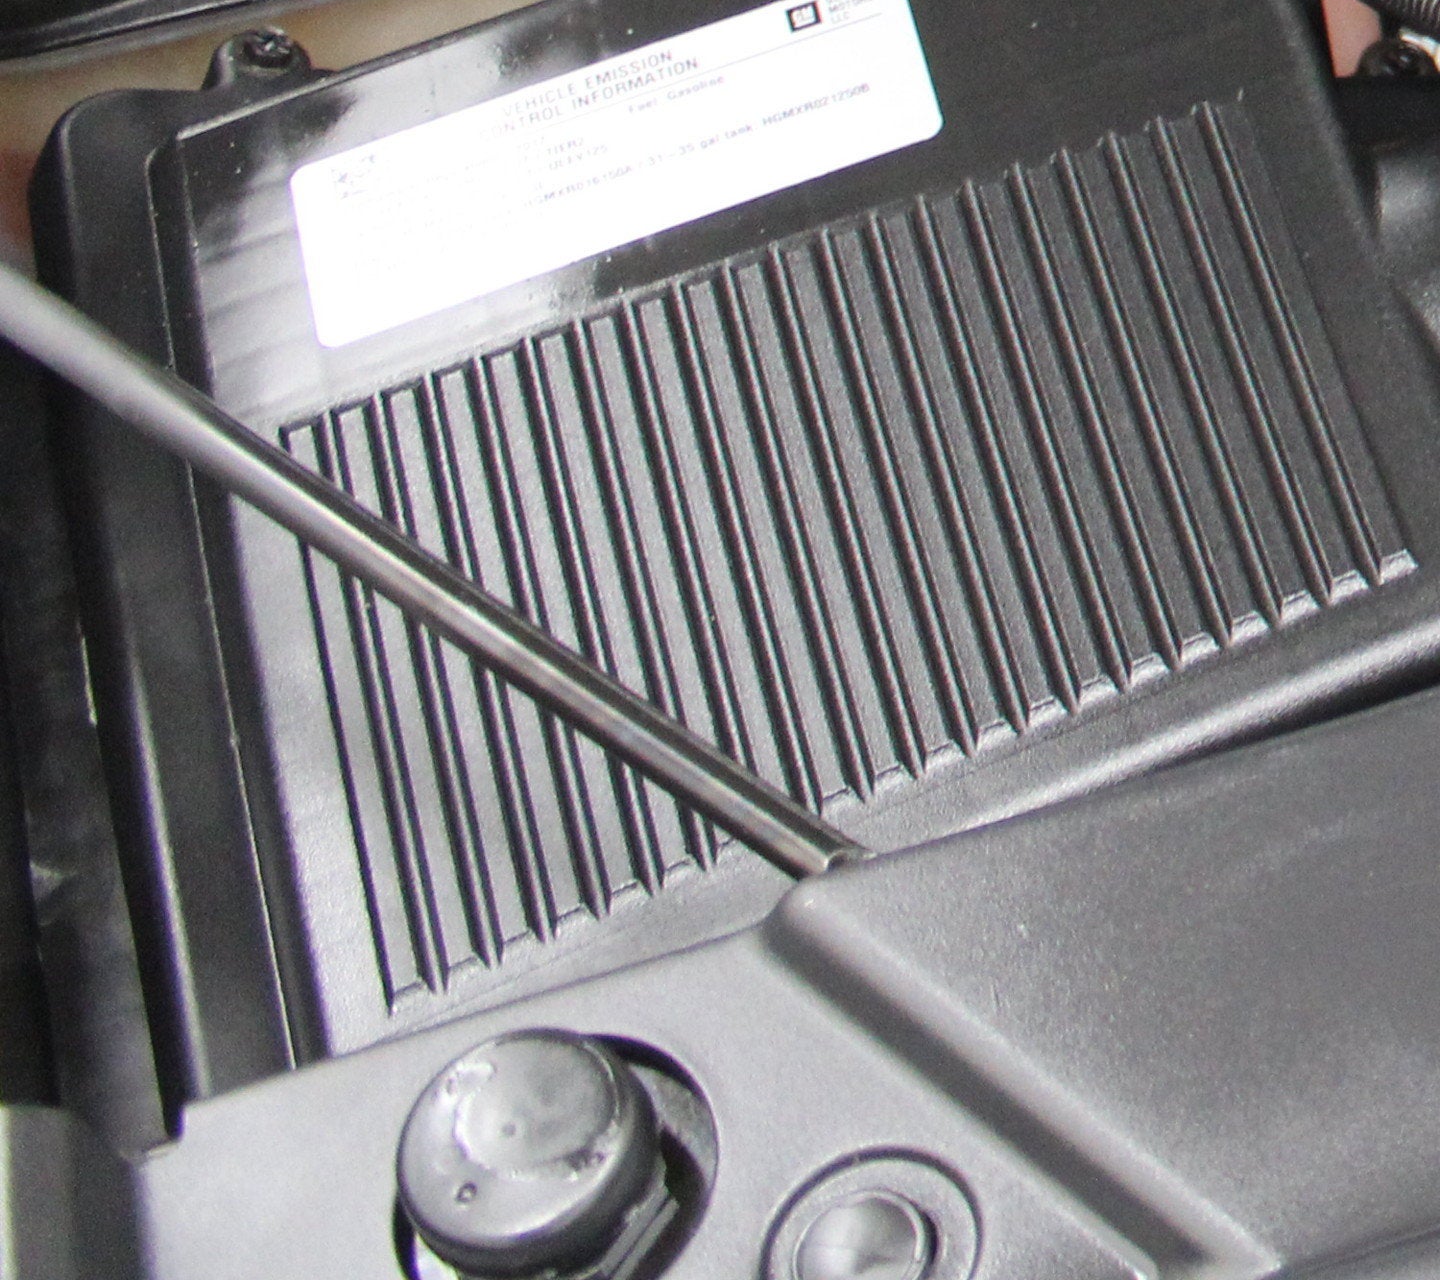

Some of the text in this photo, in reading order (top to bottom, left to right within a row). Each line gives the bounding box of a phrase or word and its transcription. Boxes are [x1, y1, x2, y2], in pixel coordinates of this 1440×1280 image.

[503, 48, 673, 117] VEHICLE EMISSION
[570, 56, 700, 109] INFORMATION
